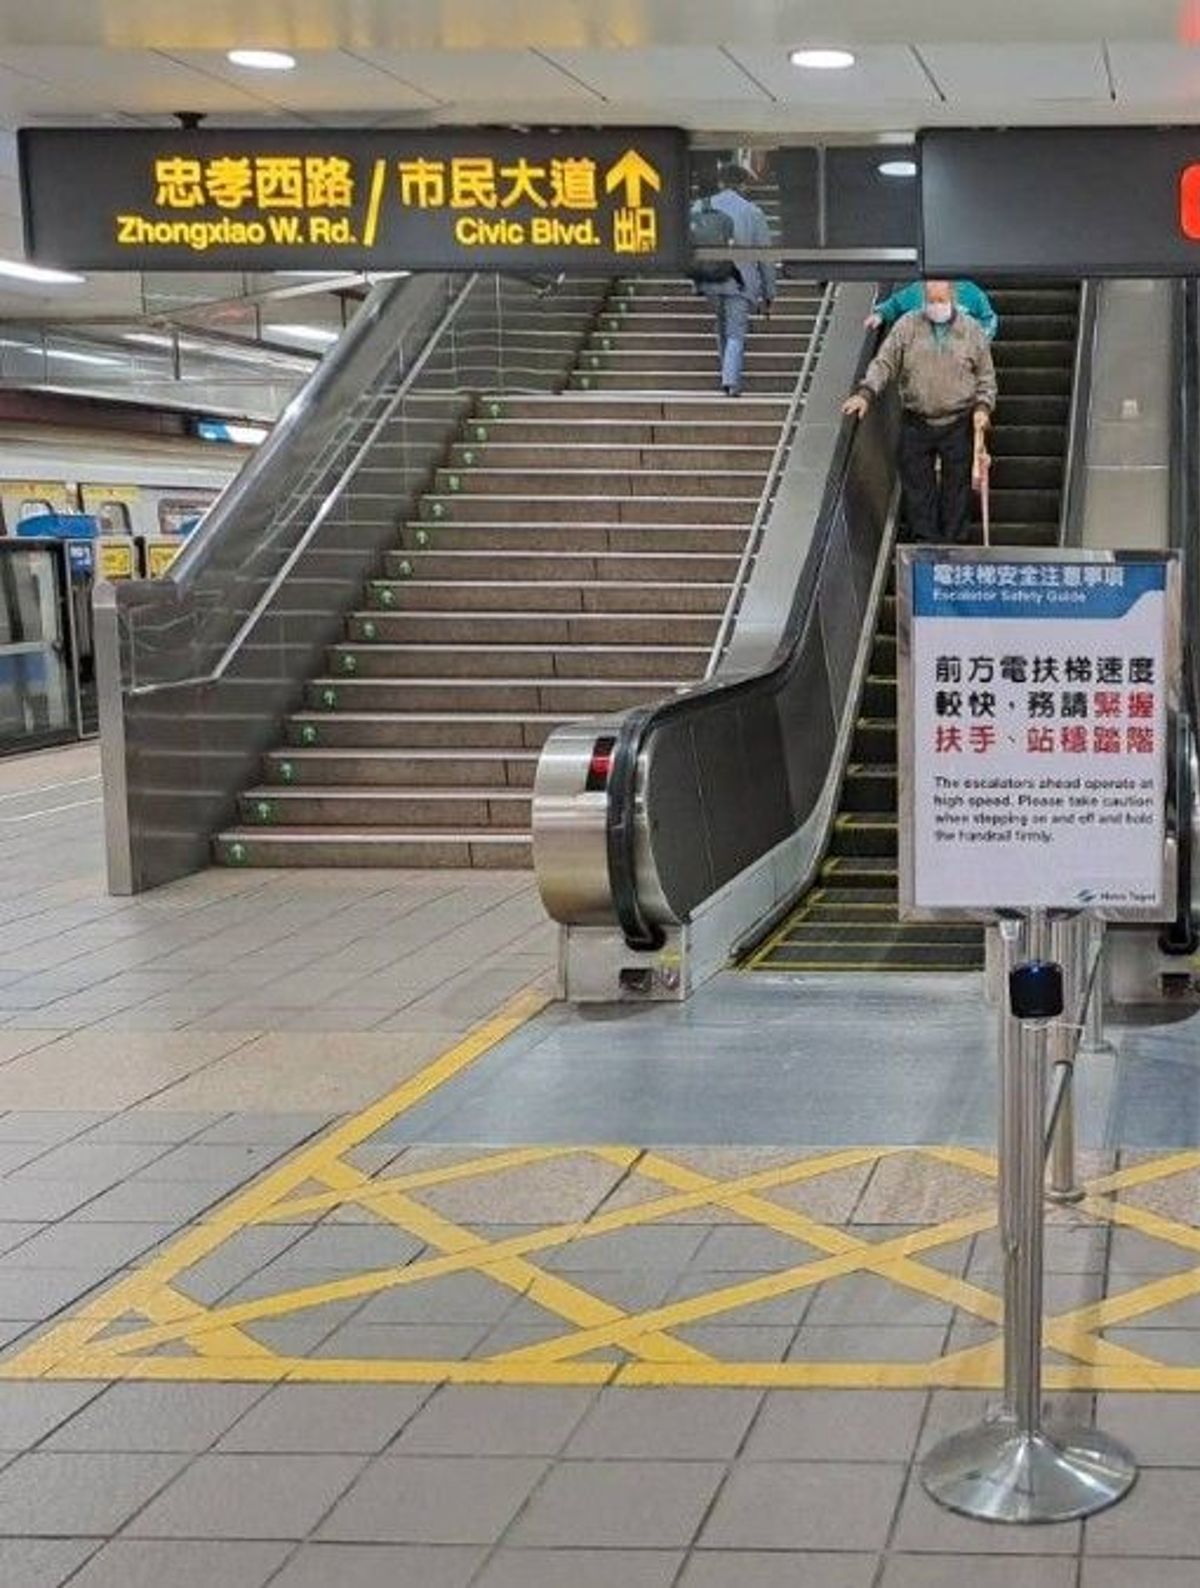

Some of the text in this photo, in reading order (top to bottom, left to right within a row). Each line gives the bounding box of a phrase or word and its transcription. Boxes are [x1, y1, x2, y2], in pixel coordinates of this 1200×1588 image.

[155, 157, 354, 208] 忠孝西路
[398, 157, 598, 209] 市民大道
[117, 216, 356, 250] Zhongxiao W. Rd.
[455, 217, 600, 244] Civic Blvd.
[933, 564, 1124, 587] 電扶梯安全注意事項
[934, 588, 997, 602] Escalator
[1001, 588, 1042, 605] Safety
[936, 656, 1154, 684] 前方電扶梯速度
[935, 776, 959, 789] The
[934, 794, 963, 808] high
[1018, 794, 1063, 806] Please
